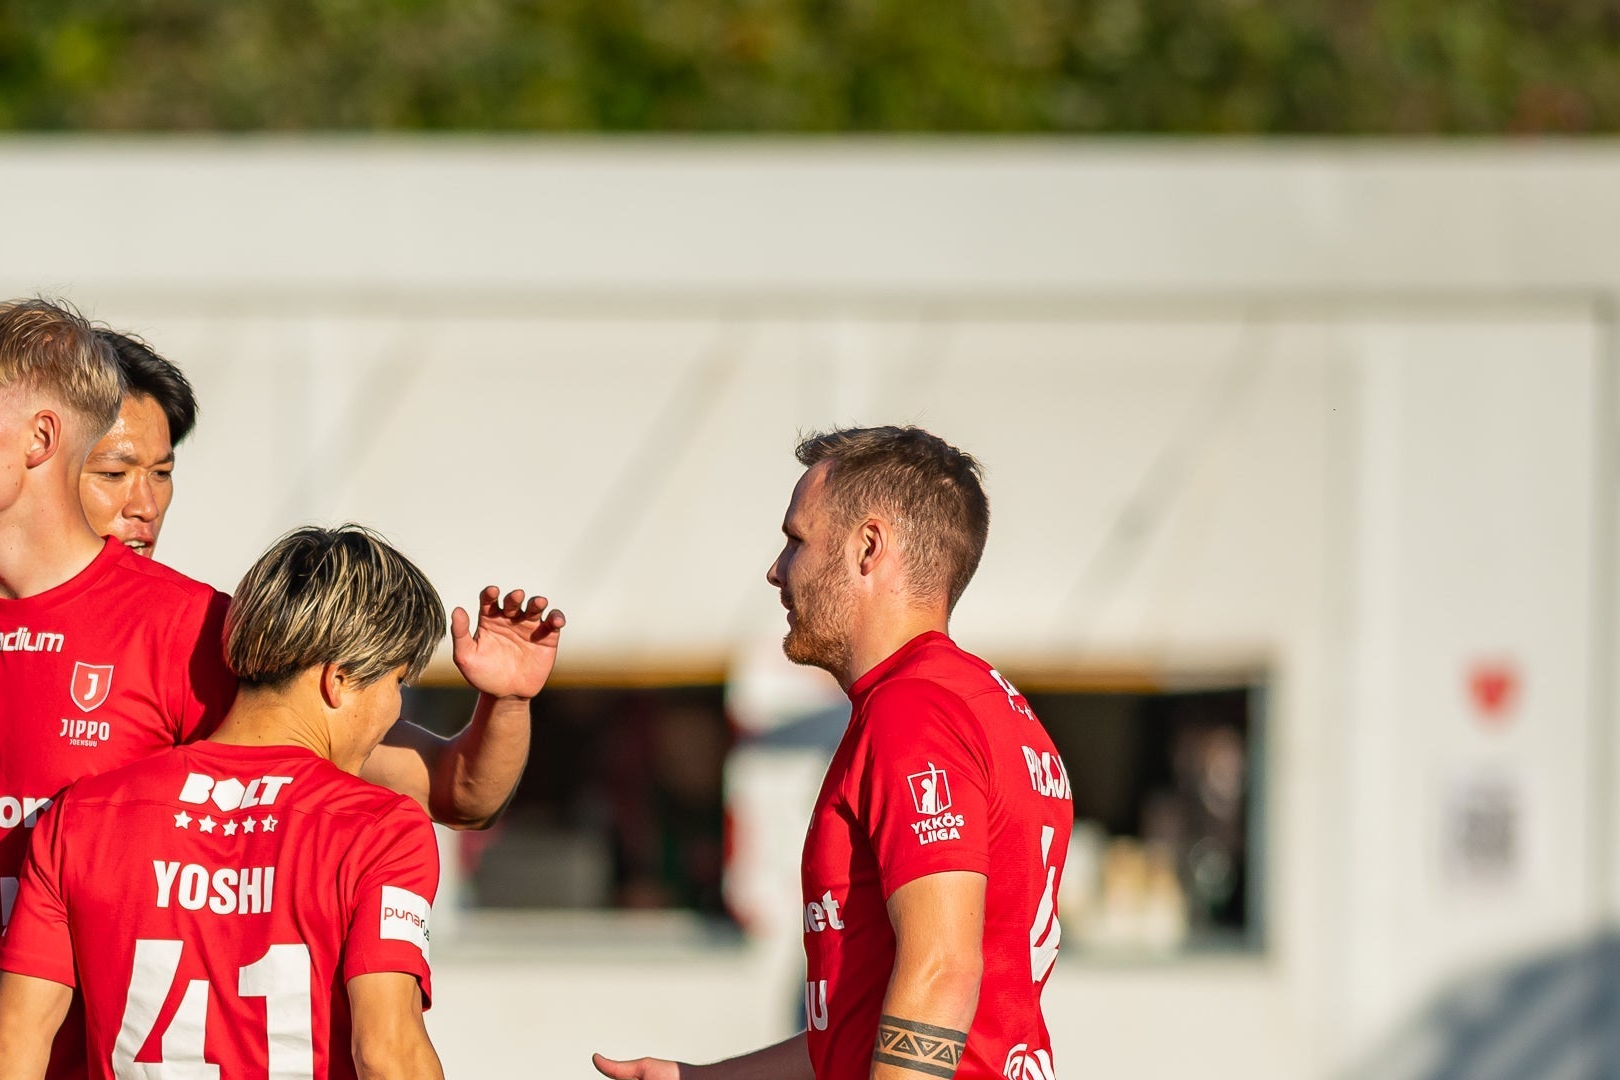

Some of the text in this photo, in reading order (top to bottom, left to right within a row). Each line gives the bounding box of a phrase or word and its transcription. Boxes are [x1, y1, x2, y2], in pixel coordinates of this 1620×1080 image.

[83, 673, 99, 701] J
[60, 718, 110, 741] JIPPO
[178, 772, 293, 812] BOLT
[910, 812, 965, 835] YKKÖS
[918, 827, 961, 846] LIIGA
[153, 860, 274, 915] YOSHI
